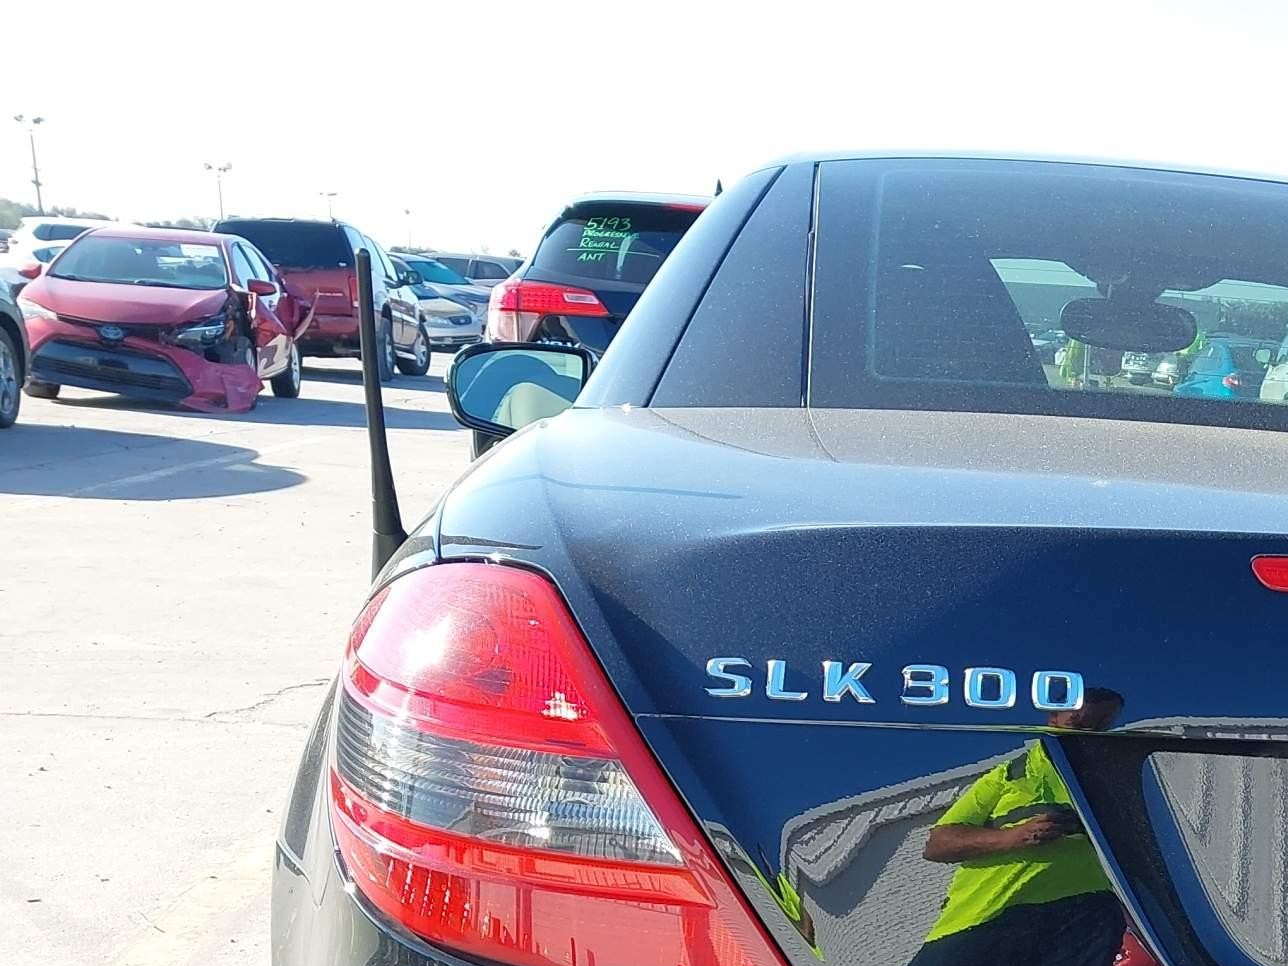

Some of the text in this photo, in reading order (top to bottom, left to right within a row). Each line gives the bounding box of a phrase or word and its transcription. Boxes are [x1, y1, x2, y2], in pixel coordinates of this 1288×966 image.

[584, 217, 631, 230] 5193
[577, 252, 606, 262] ANT
[704, 657, 1084, 711] SLK 300
